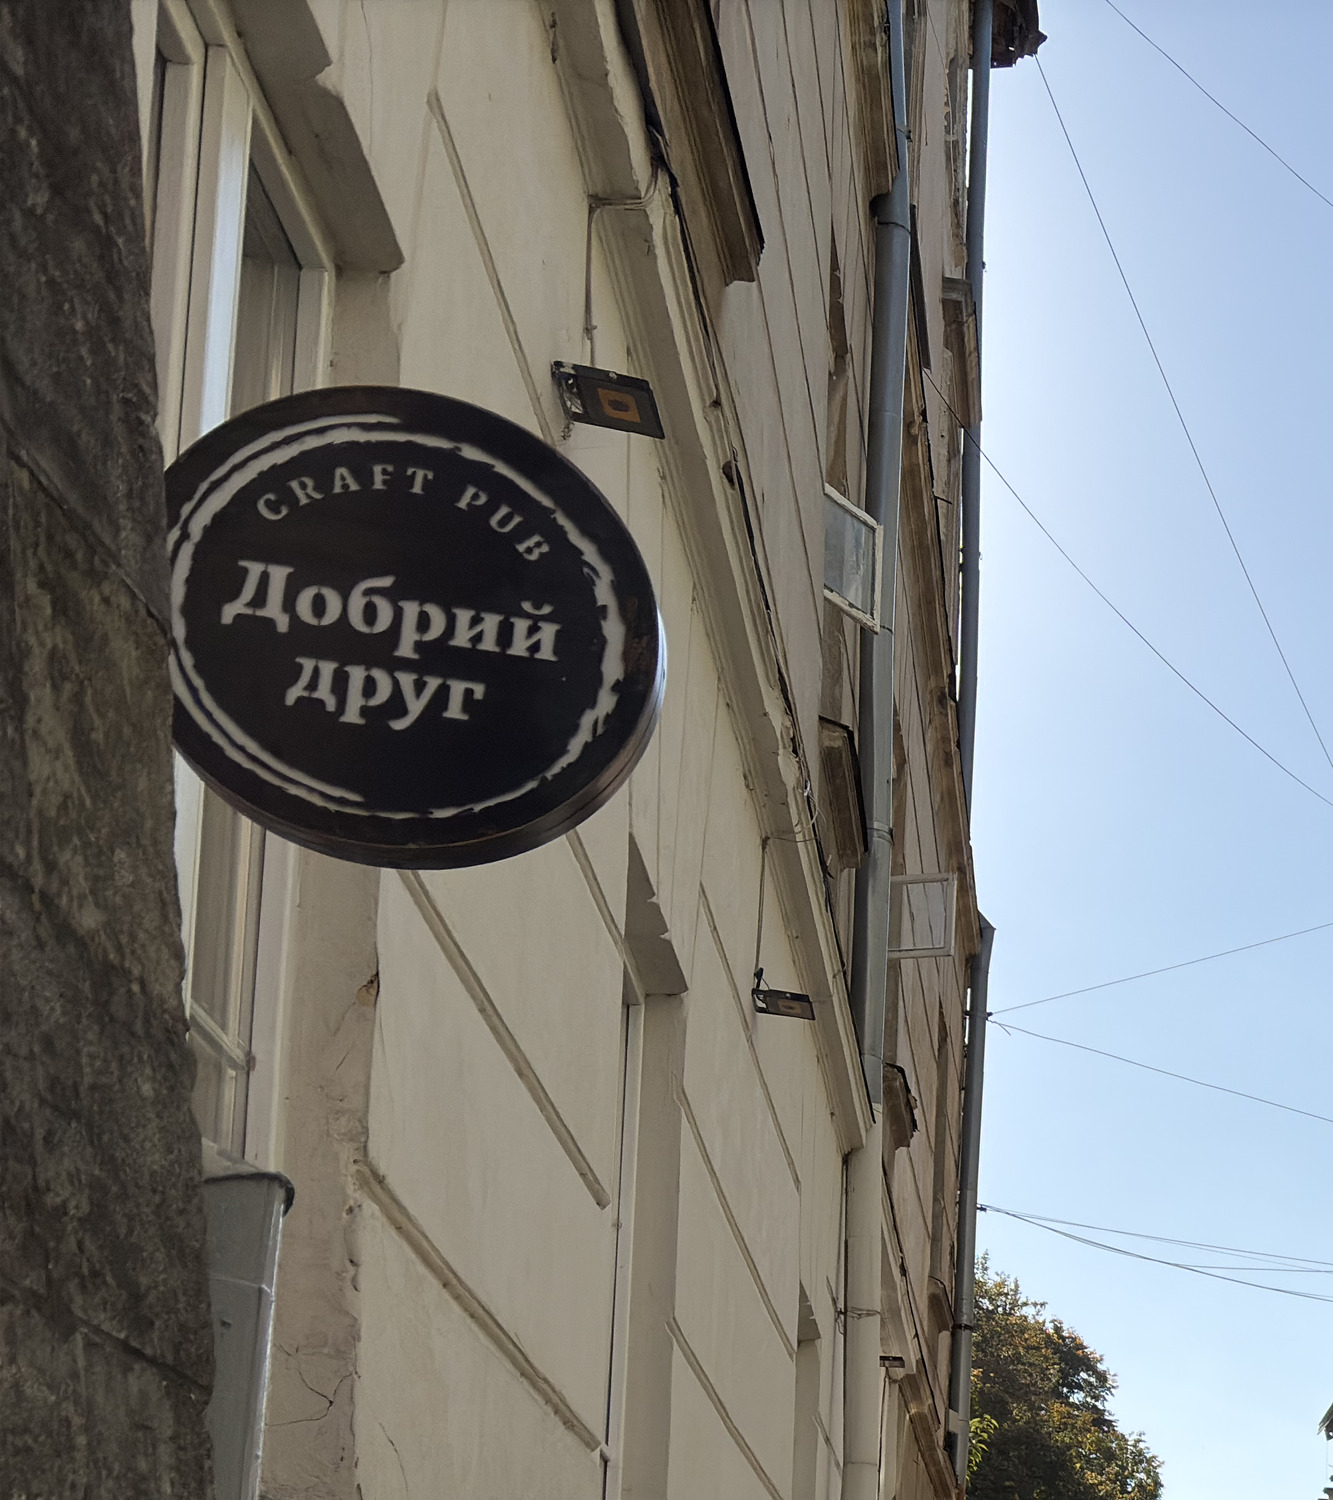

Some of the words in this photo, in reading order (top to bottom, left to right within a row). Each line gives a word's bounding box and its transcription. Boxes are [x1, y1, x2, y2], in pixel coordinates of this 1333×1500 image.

[256, 464, 434, 520] CRAFT
[455, 484, 550, 561] PUB
[220, 559, 562, 661] Добрий
[285, 656, 486, 730] друг
